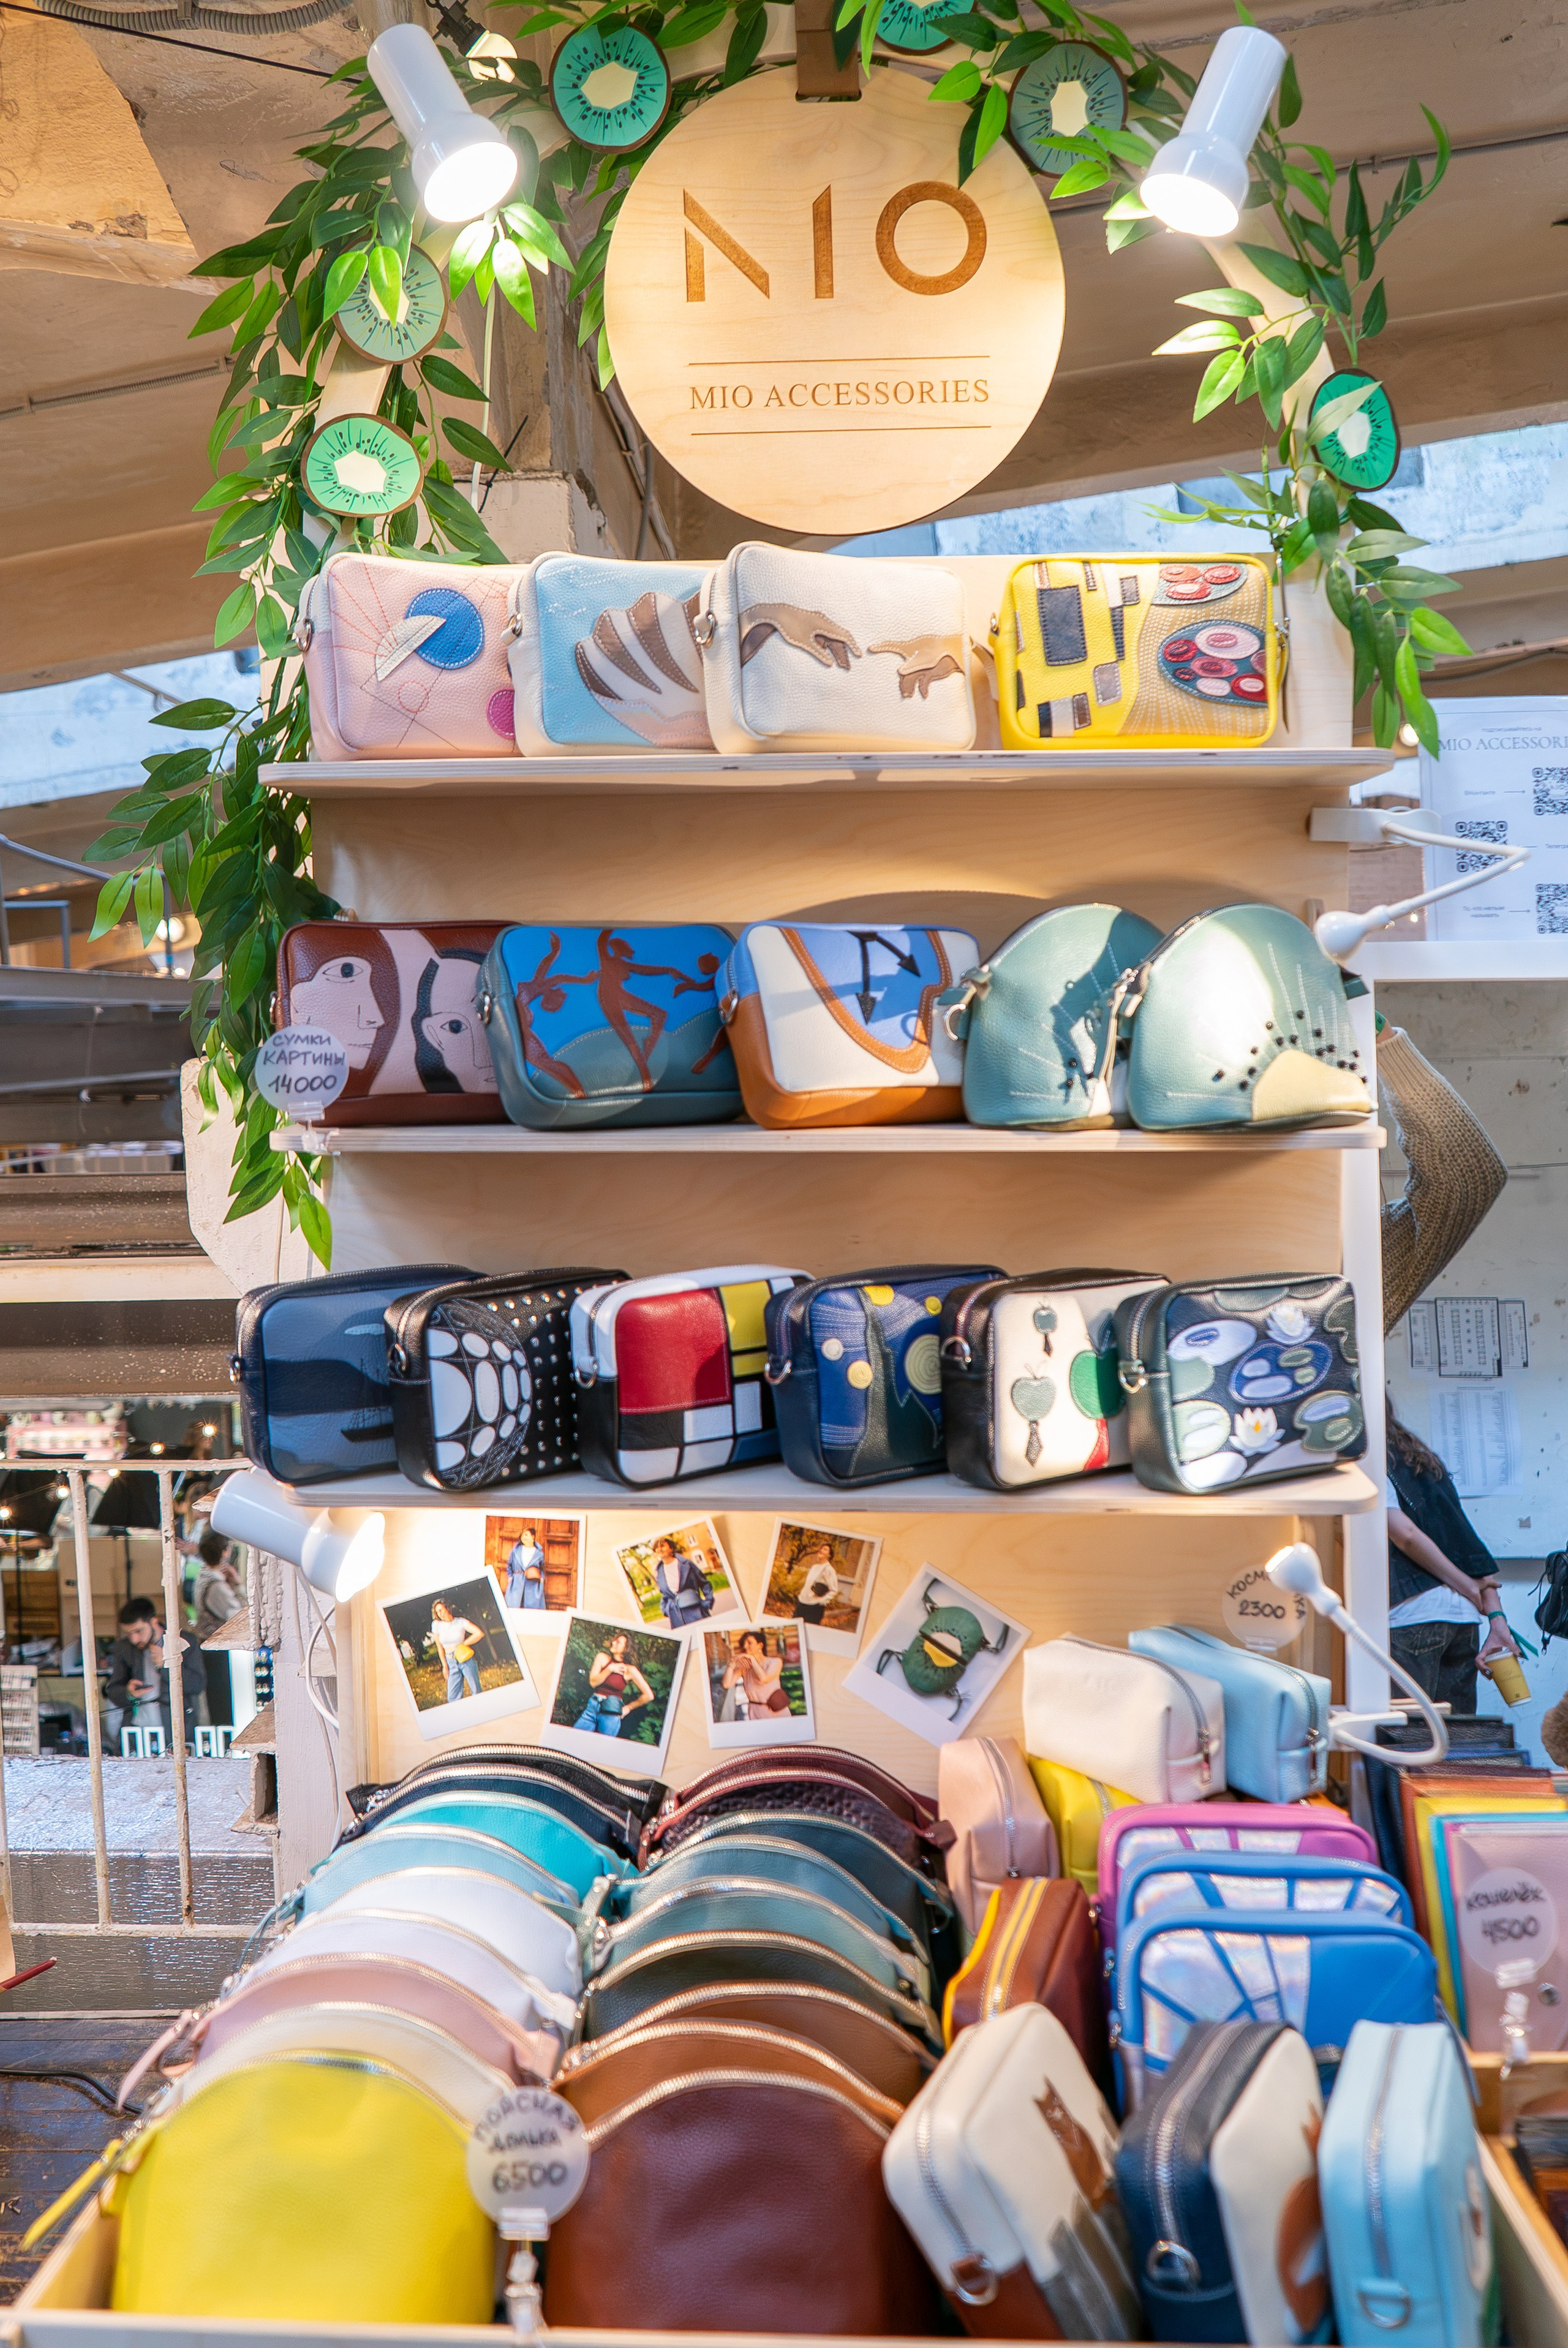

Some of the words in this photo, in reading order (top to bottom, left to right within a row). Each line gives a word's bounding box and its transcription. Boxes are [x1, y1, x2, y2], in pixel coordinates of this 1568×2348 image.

[689, 384, 753, 410] MIO
[763, 380, 990, 408] ACCESSORIES
[1439, 738, 1471, 752] MIO
[263, 1049, 345, 1066] КАРТИНЫ
[268, 1073, 337, 1093] 14000
[1238, 1599, 1286, 1619] 2300
[492, 2159, 567, 2194] 6500
